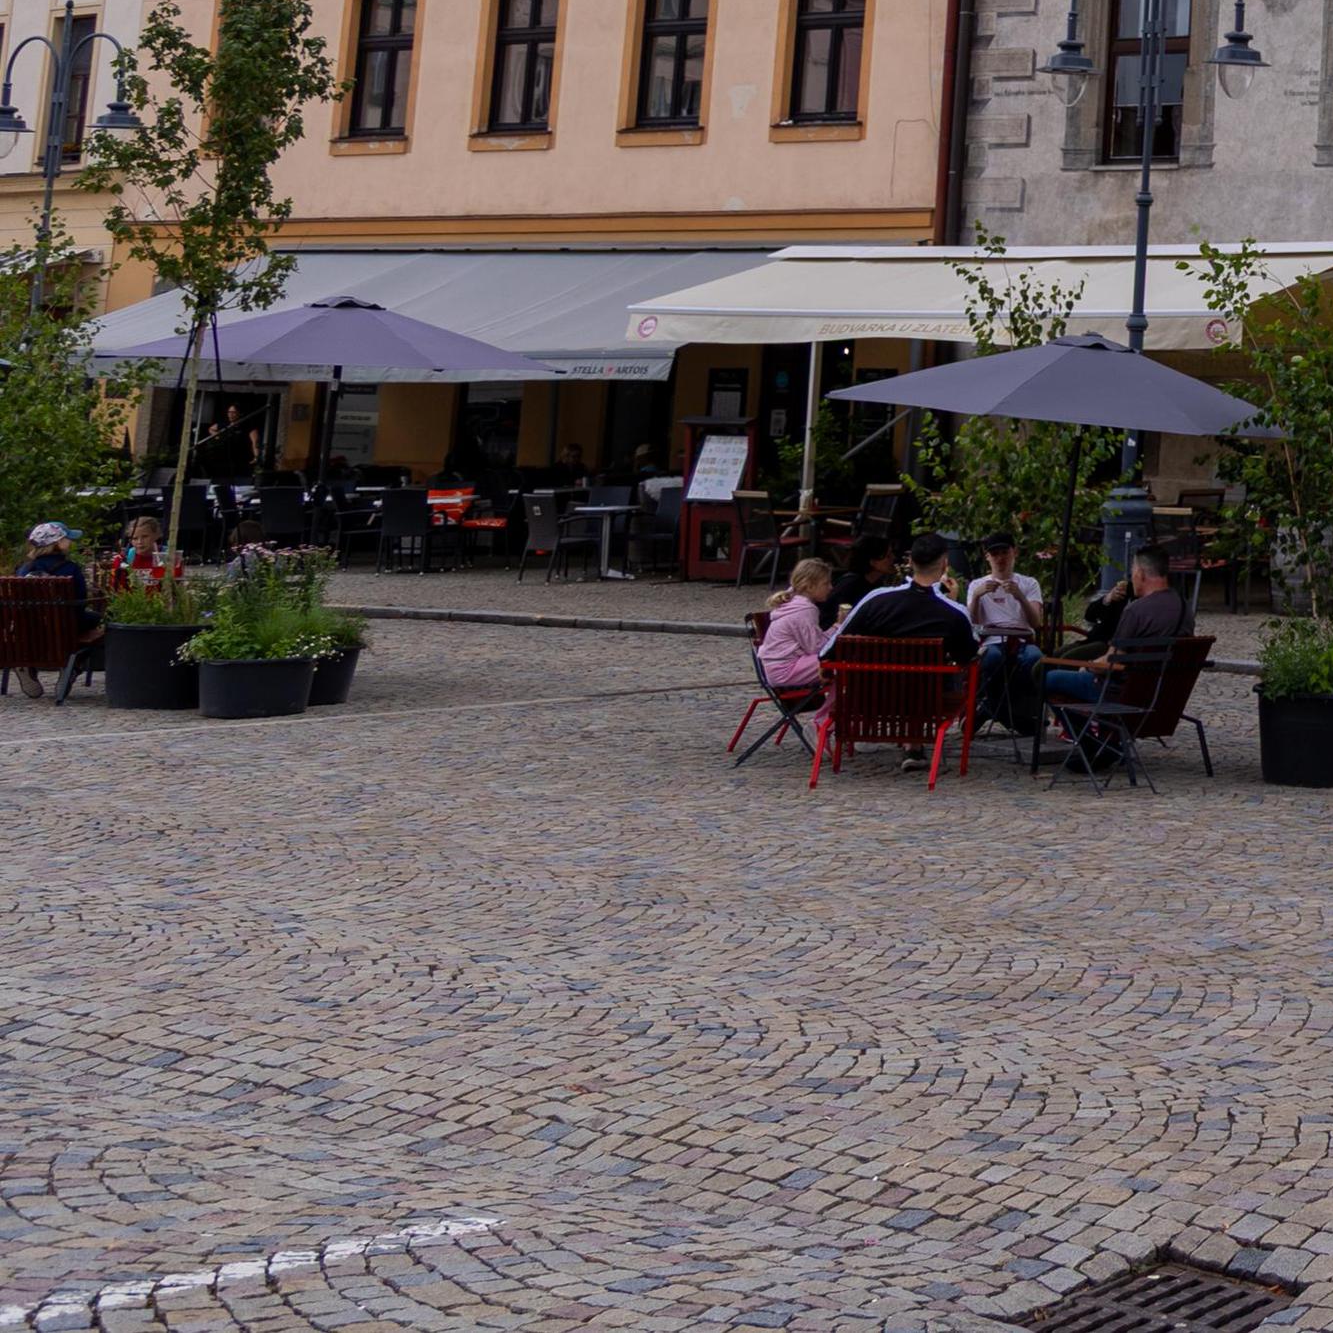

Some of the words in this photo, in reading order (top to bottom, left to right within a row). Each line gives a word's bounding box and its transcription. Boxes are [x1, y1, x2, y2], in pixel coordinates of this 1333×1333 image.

[820, 323, 897, 336] BUDVARKA
[900, 323, 912, 333] U
[913, 322, 982, 337] ZLATÉH
[572, 365, 604, 375] STELLA
[616, 365, 649, 375] ARTOIS
